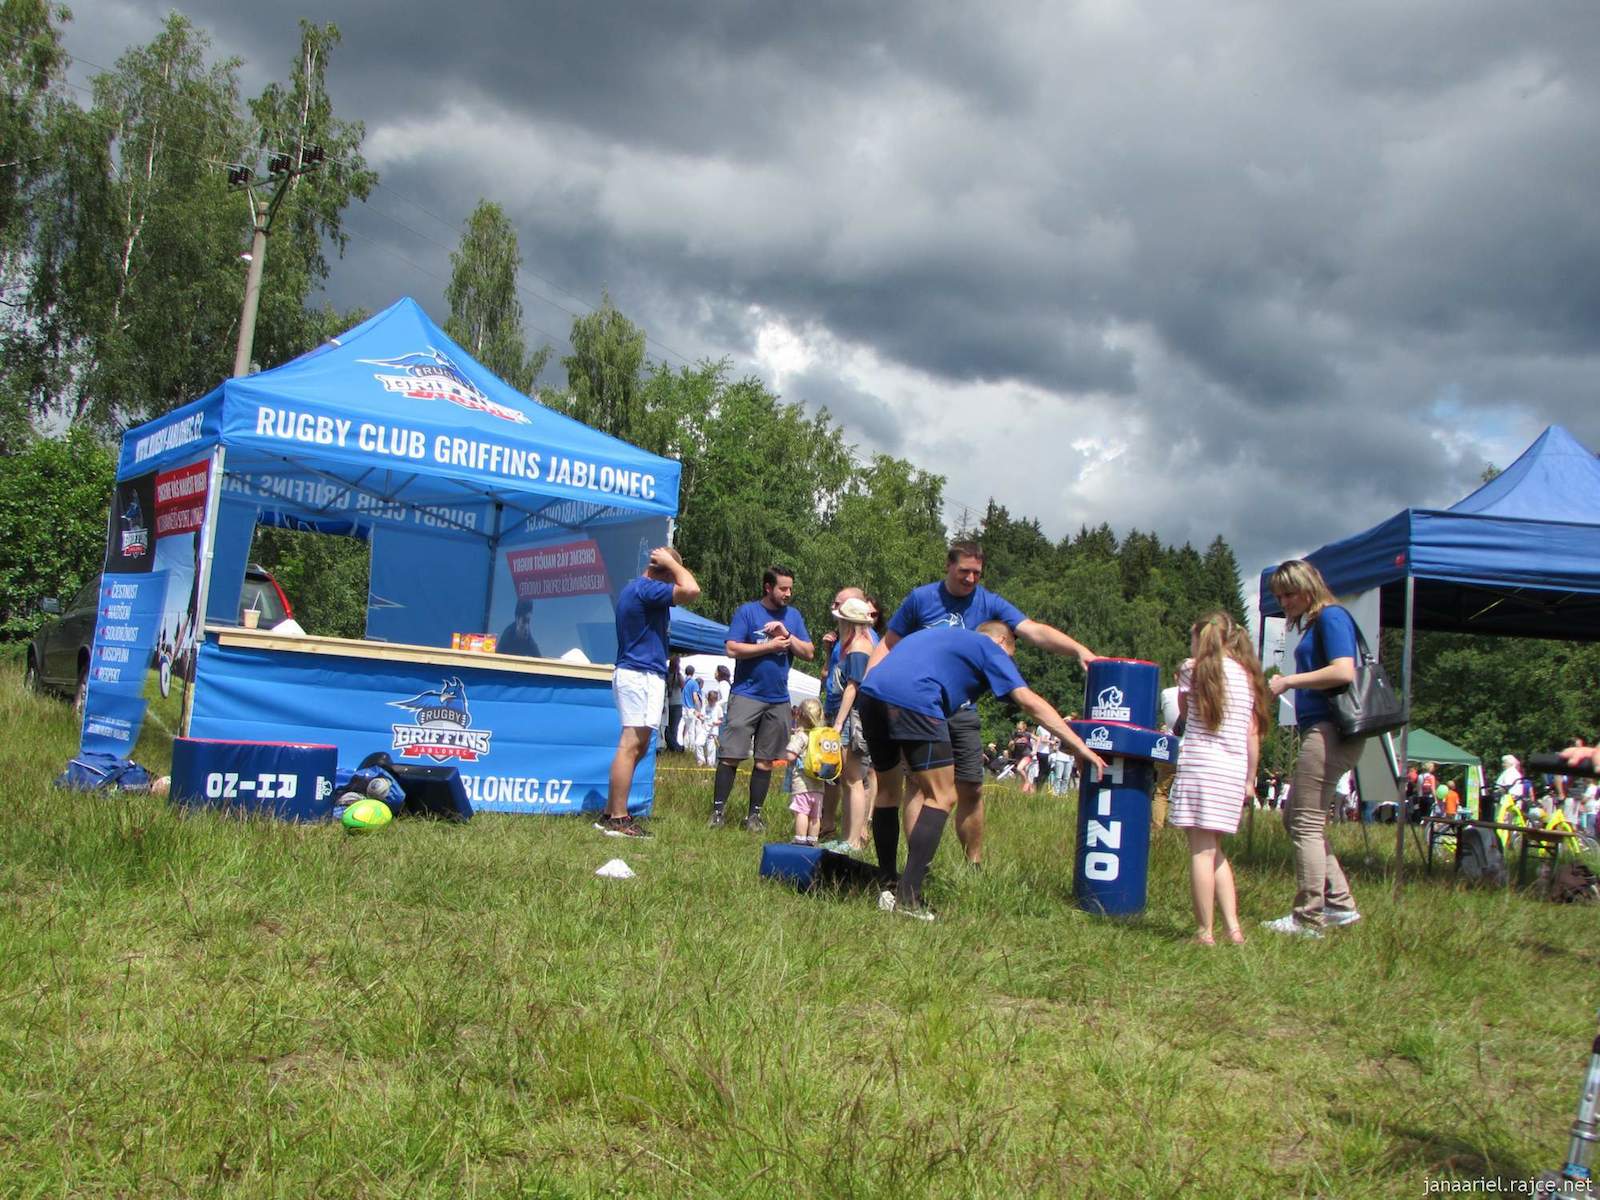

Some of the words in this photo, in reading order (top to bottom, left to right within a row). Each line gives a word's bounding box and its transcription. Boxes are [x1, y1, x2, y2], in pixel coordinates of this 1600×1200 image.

[255, 406, 352, 447] RUGBY
[358, 423, 426, 459] CLUB
[434, 435, 541, 480] GRIFFINS
[546, 456, 656, 499] JABLONEC
[426, 709, 461, 721] RUGBY
[1092, 709, 1129, 719] RHINO
[394, 726, 489, 753] GRIFFINS
[414, 747, 468, 756] JABLONEC
